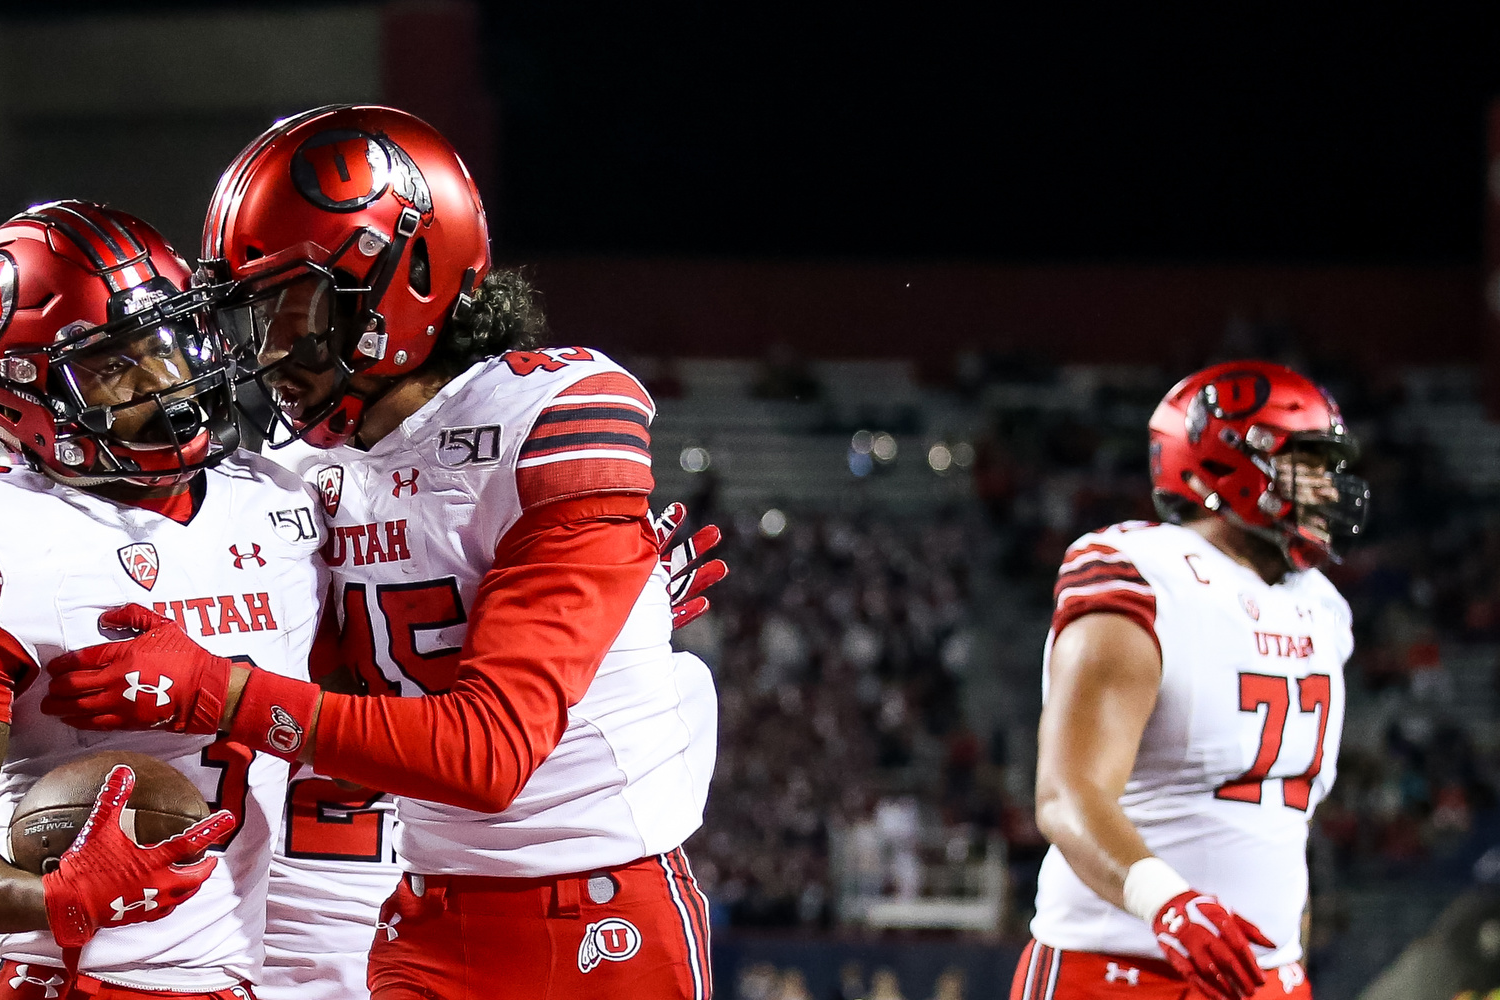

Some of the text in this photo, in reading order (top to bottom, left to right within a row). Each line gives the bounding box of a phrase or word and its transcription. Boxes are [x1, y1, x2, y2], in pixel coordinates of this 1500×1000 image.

[303, 137, 374, 203] U
[438, 424, 502, 467] 150
[267, 506, 318, 542] 150
[320, 518, 411, 567] UTAH
[120, 544, 158, 575] PAC
[134, 562, 156, 582] 12
[1213, 671, 1330, 812] 77
[600, 927, 629, 954] U
